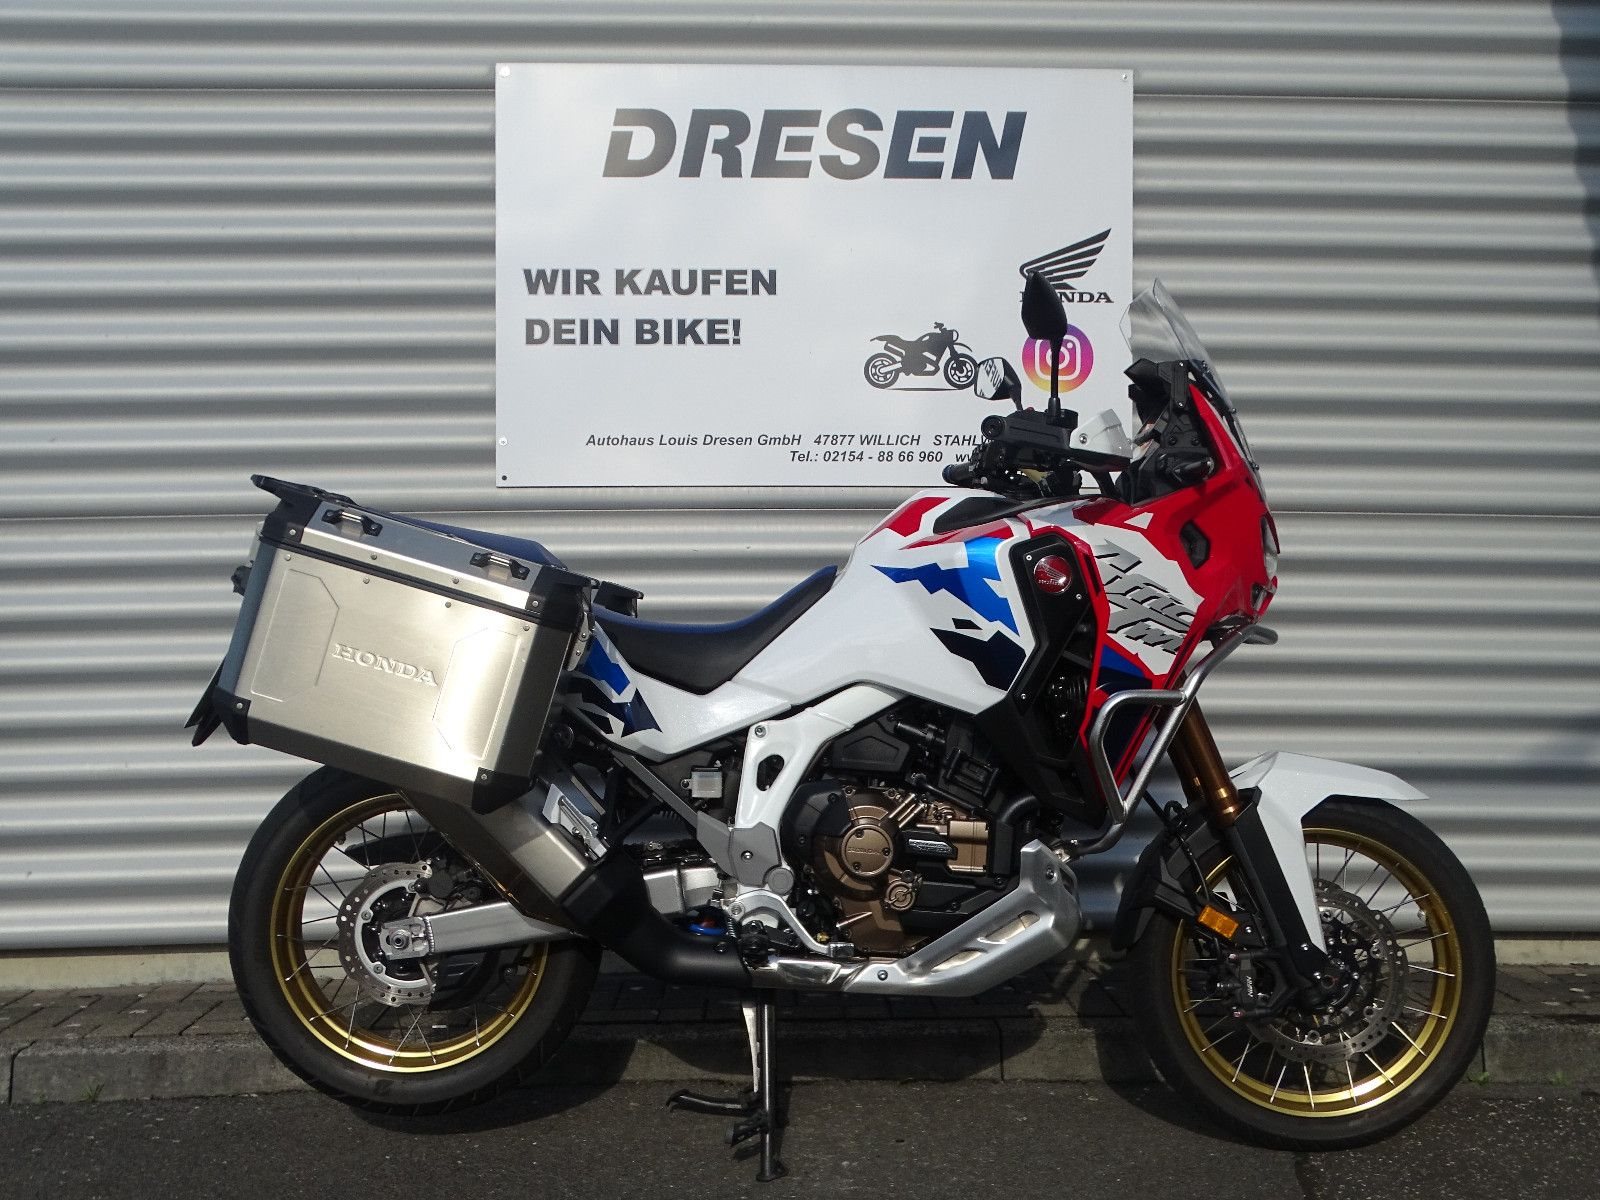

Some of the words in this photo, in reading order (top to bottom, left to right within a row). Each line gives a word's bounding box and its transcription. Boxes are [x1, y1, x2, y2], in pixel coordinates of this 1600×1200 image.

[602, 108, 1028, 181] DRESEN
[523, 268, 601, 296] WIR
[615, 269, 777, 296] KAUFEN
[1019, 291, 1114, 304] NDA
[525, 318, 619, 345] DEIN
[635, 318, 742, 345] BIKE!
[585, 434, 655, 446] Autohaus
[658, 434, 698, 446] Louis
[702, 434, 753, 446] Dresen
[757, 434, 802, 446] GmbH
[813, 434, 856, 446] 47877
[859, 434, 921, 446] WILLICH
[789, 450, 819, 463] Tel.:
[823, 450, 864, 463] 02154
[877, 450, 894, 463] 88
[898, 450, 915, 463] 66
[918, 450, 943, 463] 960
[332, 643, 438, 686] HONDA
